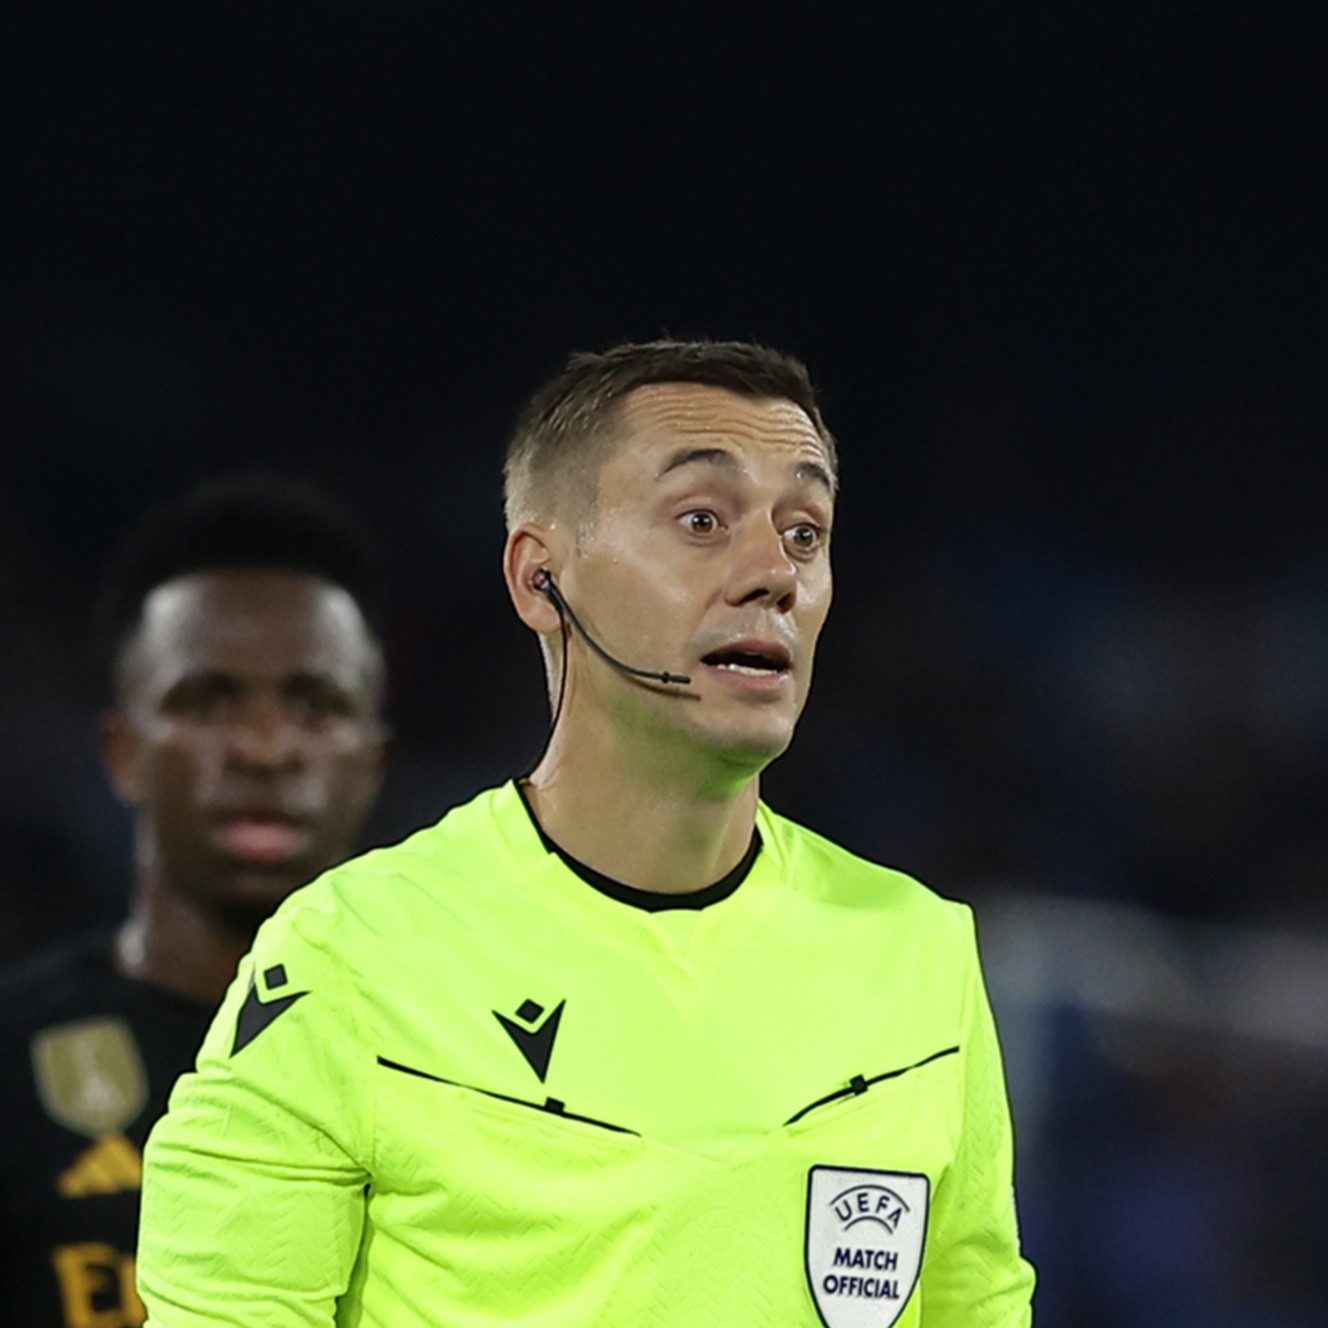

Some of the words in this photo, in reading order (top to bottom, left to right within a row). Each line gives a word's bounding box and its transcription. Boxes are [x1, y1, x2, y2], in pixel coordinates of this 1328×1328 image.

[835, 1192, 903, 1229] UEFA
[833, 1247, 899, 1271] MATCH
[822, 1274, 900, 1300] OFFICIAL
